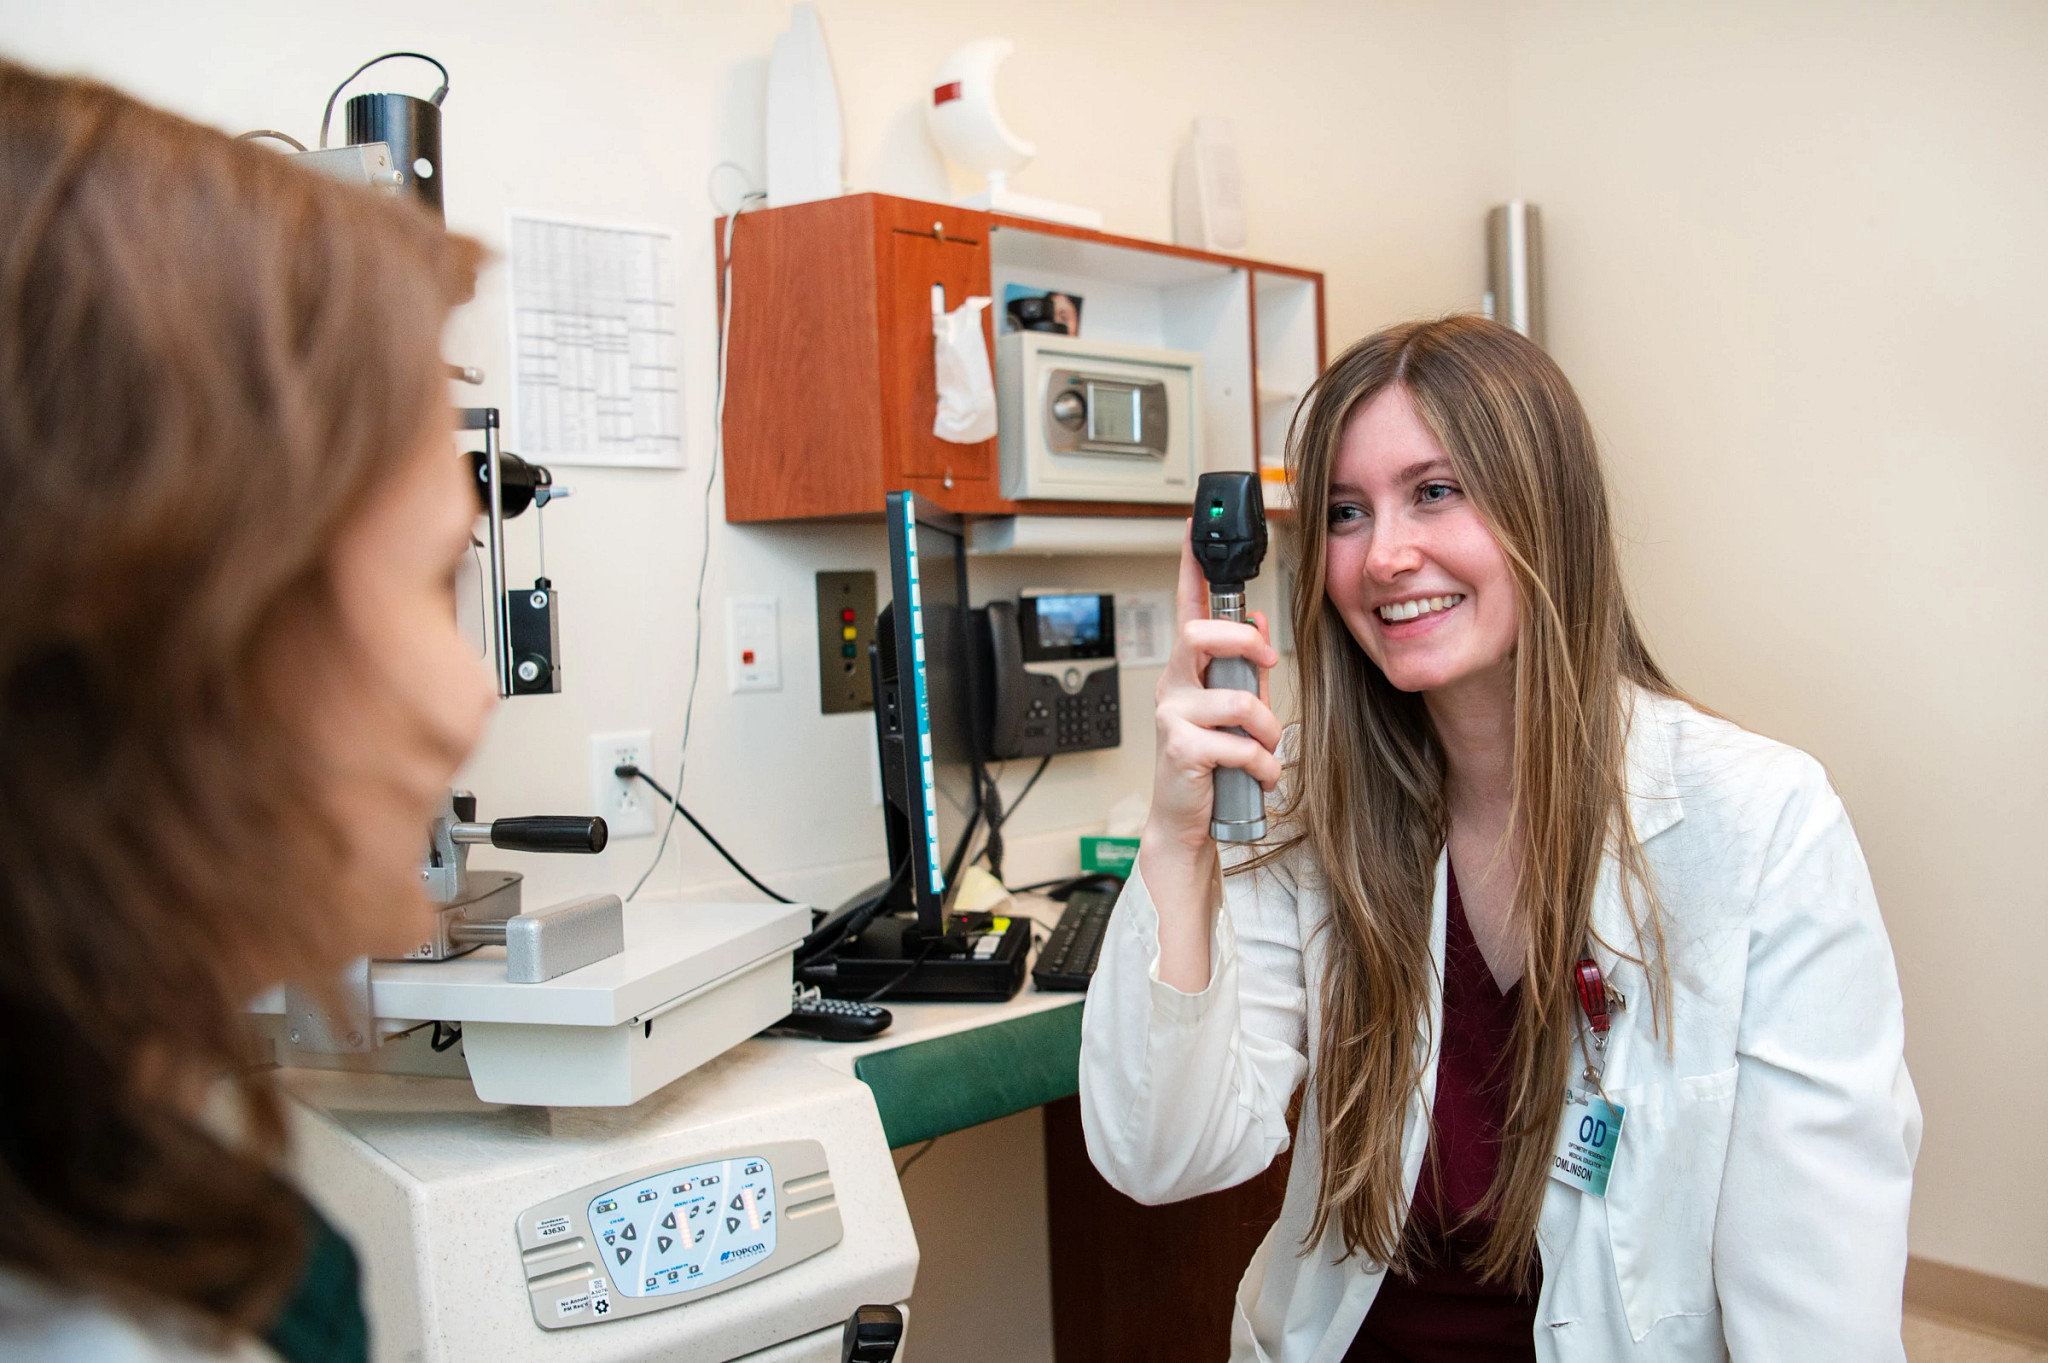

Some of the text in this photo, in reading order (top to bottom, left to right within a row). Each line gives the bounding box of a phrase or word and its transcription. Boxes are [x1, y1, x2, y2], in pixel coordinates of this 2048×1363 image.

[1579, 1115, 1607, 1148] OD
[1553, 1155, 1592, 1181] TOMLINSON
[1569, 1152, 1601, 1168] MEDICAL EDUCATION
[542, 1225, 566, 1236] 43630
[730, 1242, 766, 1258] TOPCON
